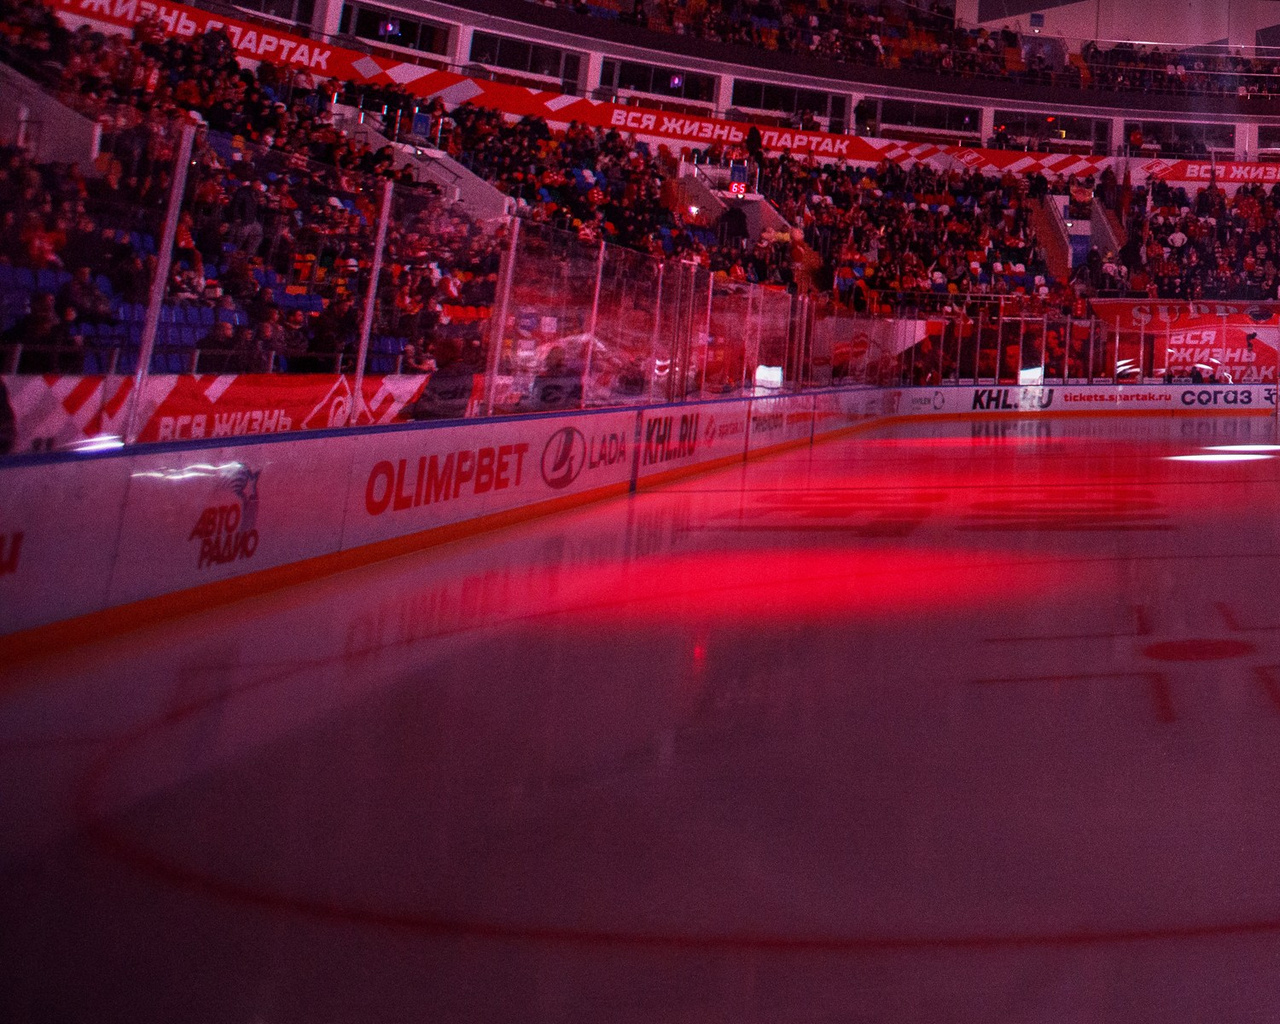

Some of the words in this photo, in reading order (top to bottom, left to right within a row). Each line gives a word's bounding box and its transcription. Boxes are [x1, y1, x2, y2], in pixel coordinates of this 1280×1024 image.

[610, 108, 656, 128] ВСЯ
[1185, 164, 1225, 179] ВСЯ
[1170, 331, 1217, 345] ВСЯ
[1170, 348, 1257, 363] ЖИЗНЬ
[971, 388, 1054, 410] KHL.RU
[1063, 392, 1172, 403] tickets.spartak.ru
[211, 409, 293, 438] ЖИЗНЬ
[642, 413, 700, 466] KHL.RU
[588, 431, 627, 470] LADA
[364, 443, 530, 517] OLIMPBET
